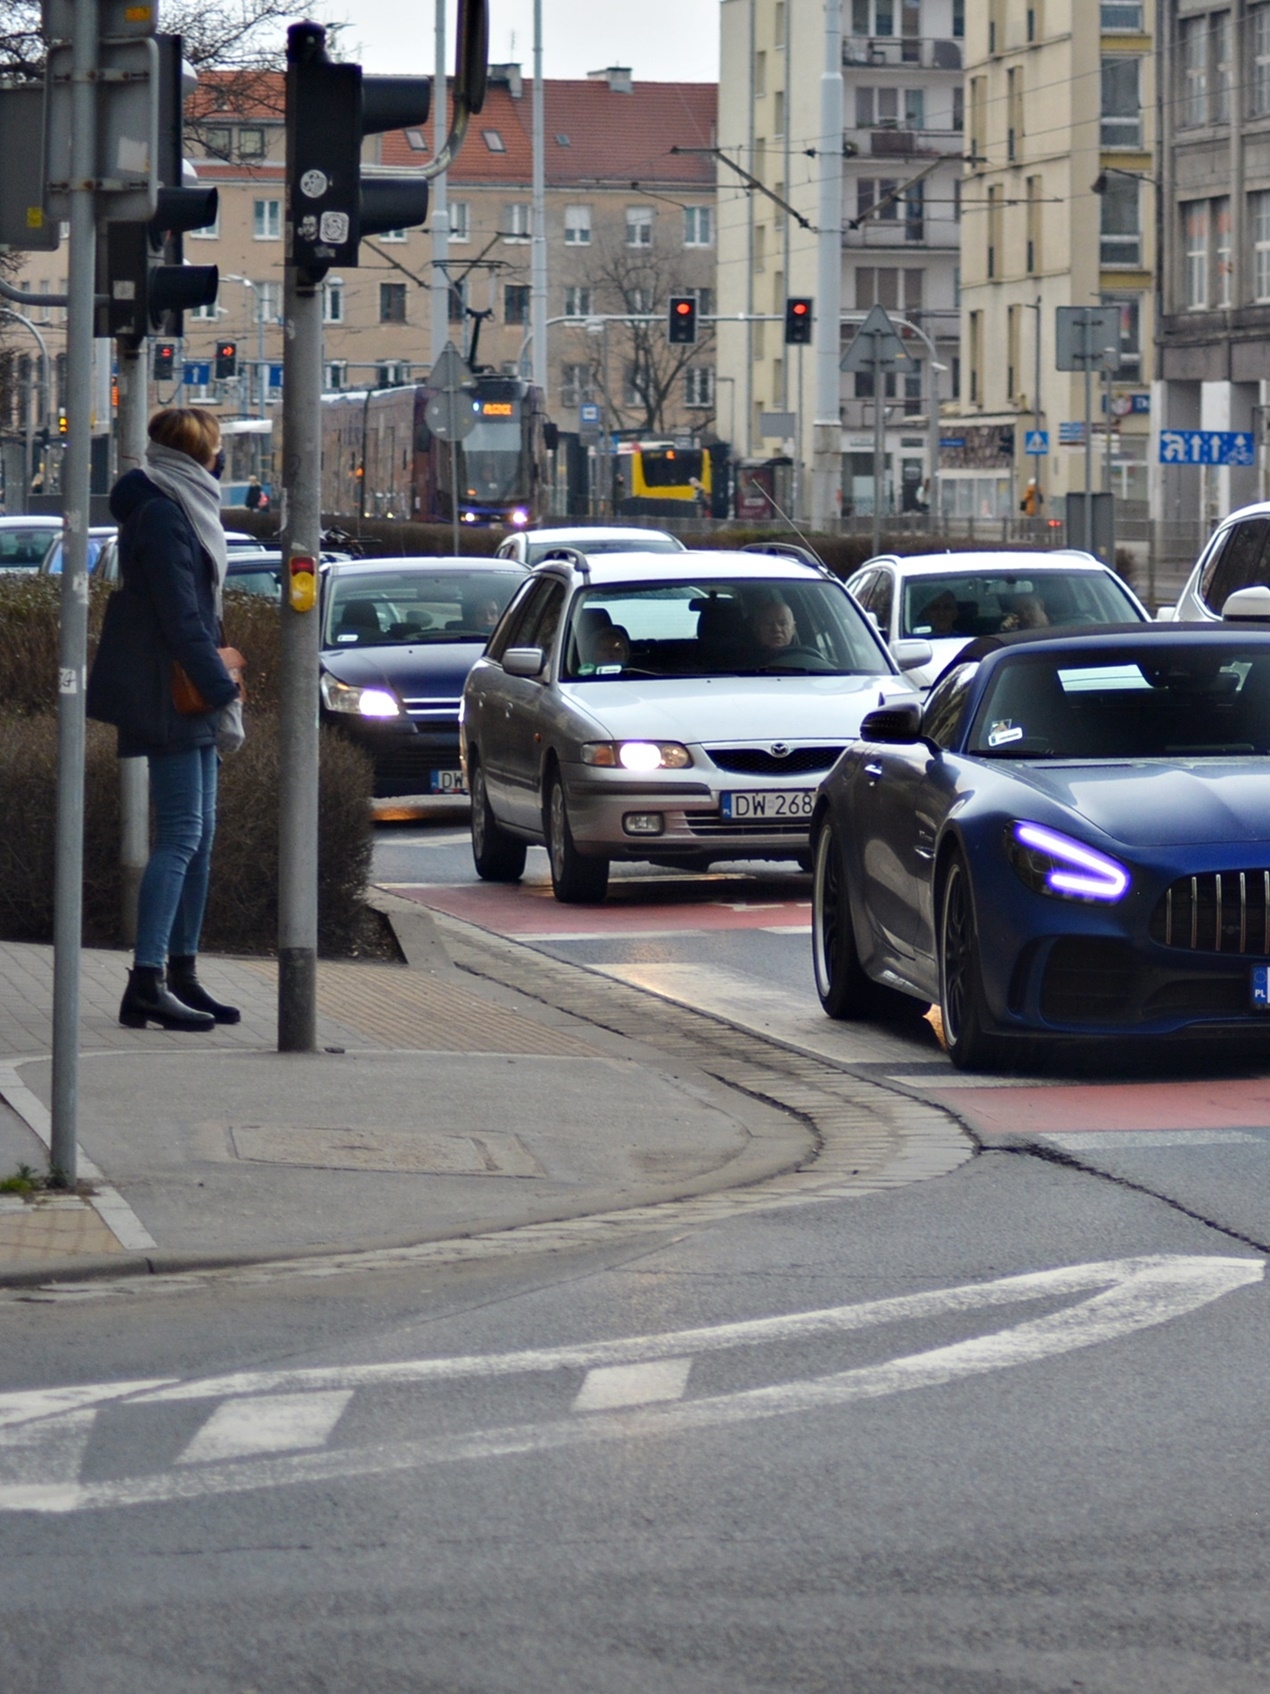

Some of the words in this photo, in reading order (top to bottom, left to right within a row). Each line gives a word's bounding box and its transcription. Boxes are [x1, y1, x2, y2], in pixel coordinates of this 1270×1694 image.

[442, 772, 464, 788] DW
[735, 795, 766, 816] DW
[774, 794, 813, 815] 268
[1254, 989, 1266, 998] PL
